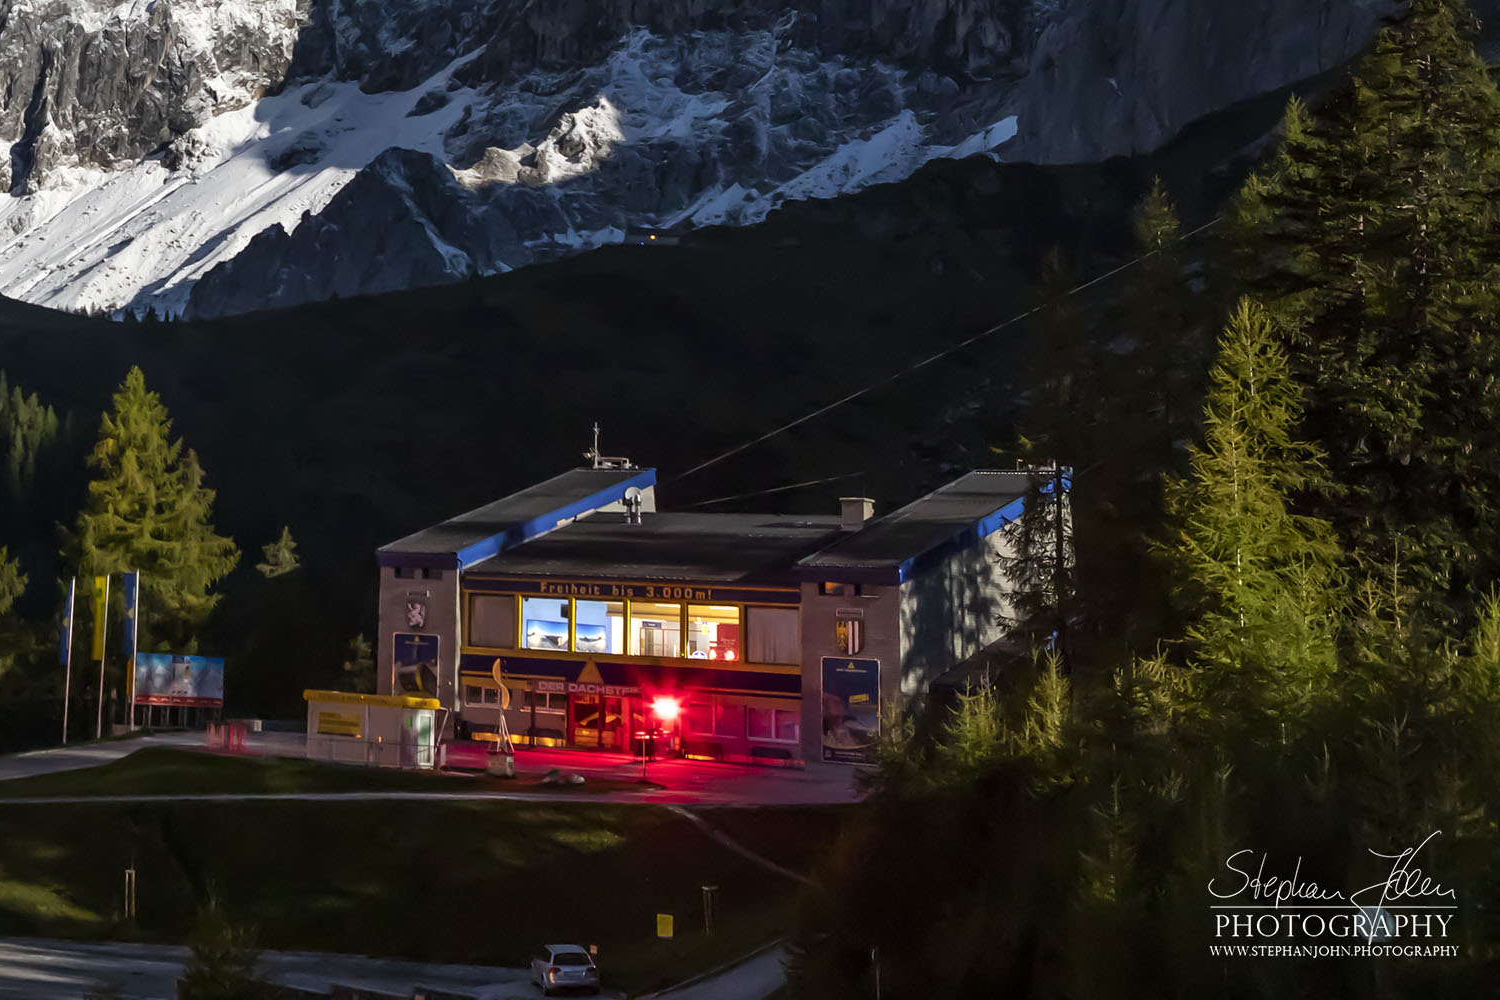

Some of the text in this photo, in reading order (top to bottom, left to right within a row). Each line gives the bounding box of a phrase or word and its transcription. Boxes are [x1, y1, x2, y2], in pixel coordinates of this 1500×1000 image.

[540, 581, 712, 600] Freiheit bis 3.000m!
[538, 681, 565, 691] DER
